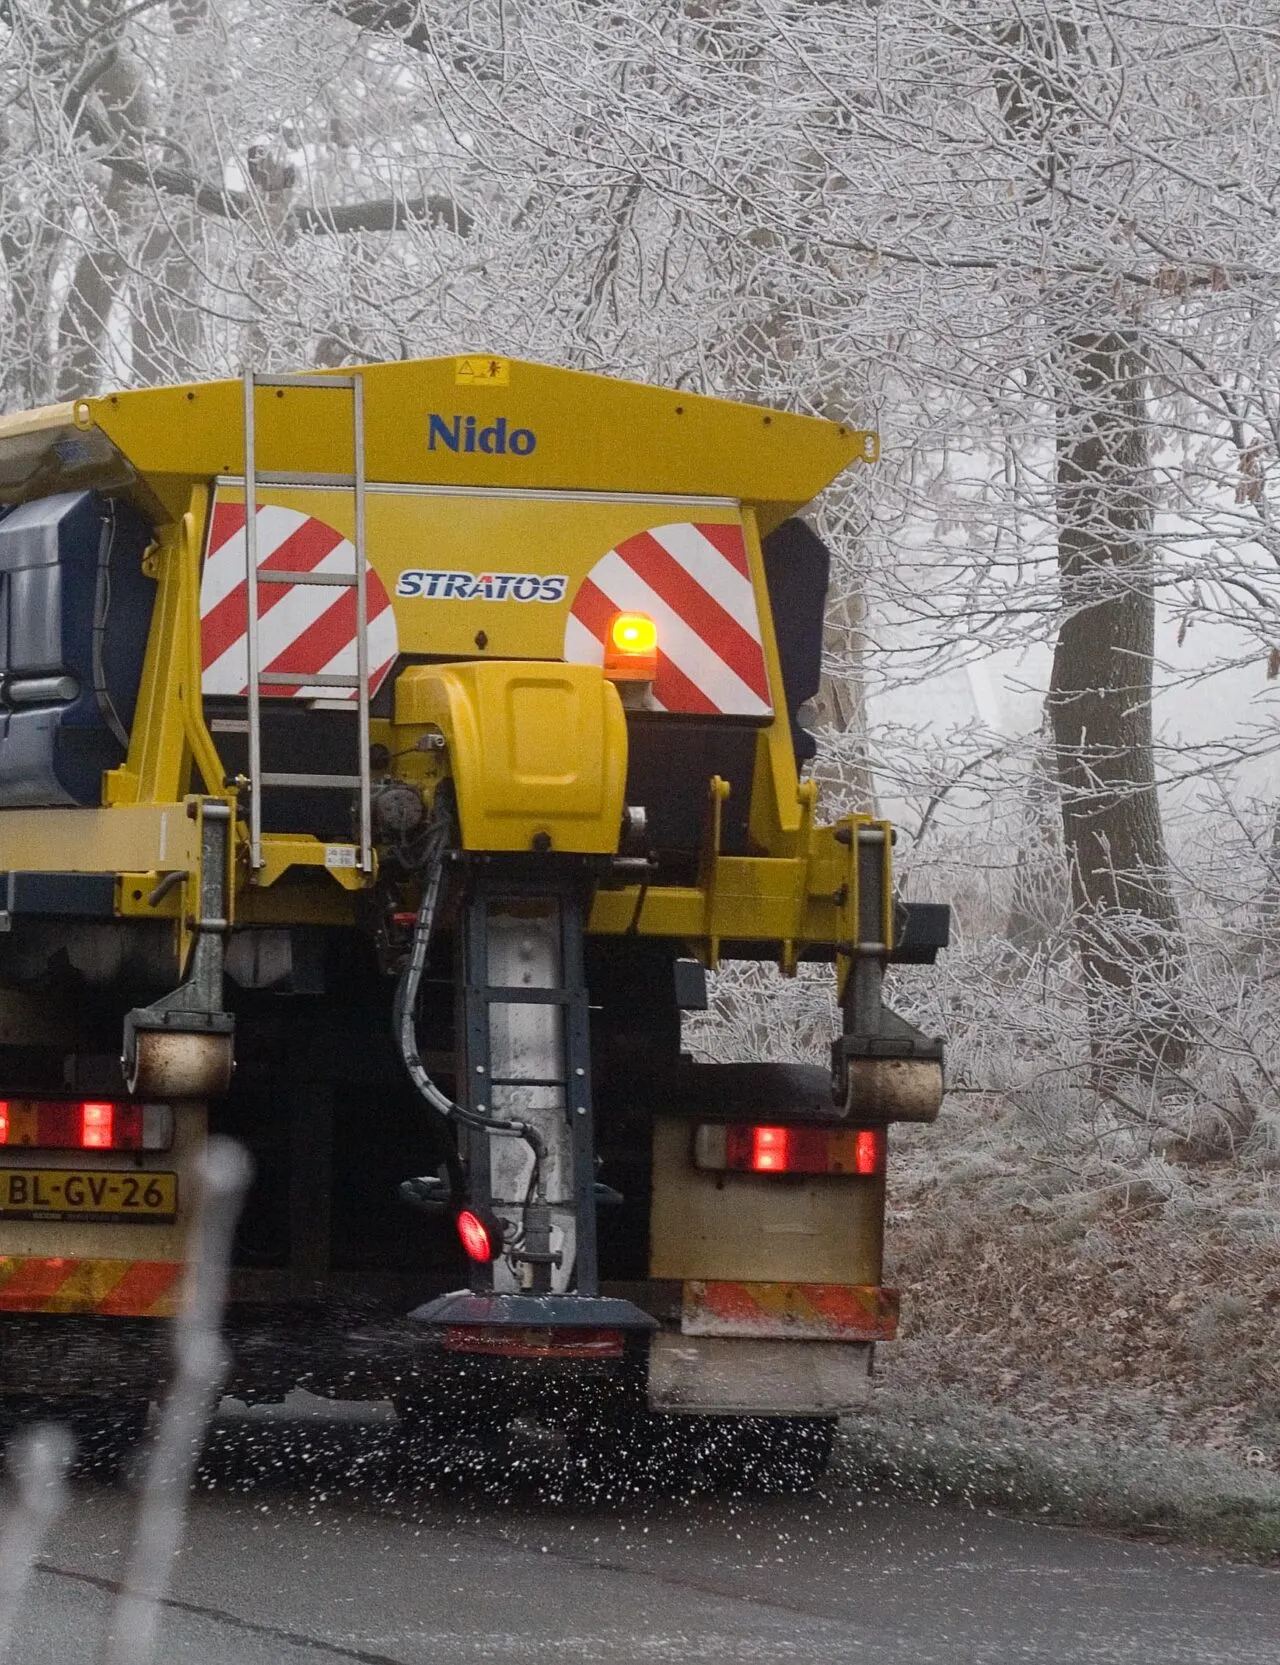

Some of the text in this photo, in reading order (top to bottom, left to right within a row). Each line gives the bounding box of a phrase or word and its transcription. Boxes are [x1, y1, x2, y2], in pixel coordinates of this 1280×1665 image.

[427, 413, 537, 456] Nido
[398, 572, 566, 601] STRATOS
[8, 1175, 164, 1208] BL-GV-26
